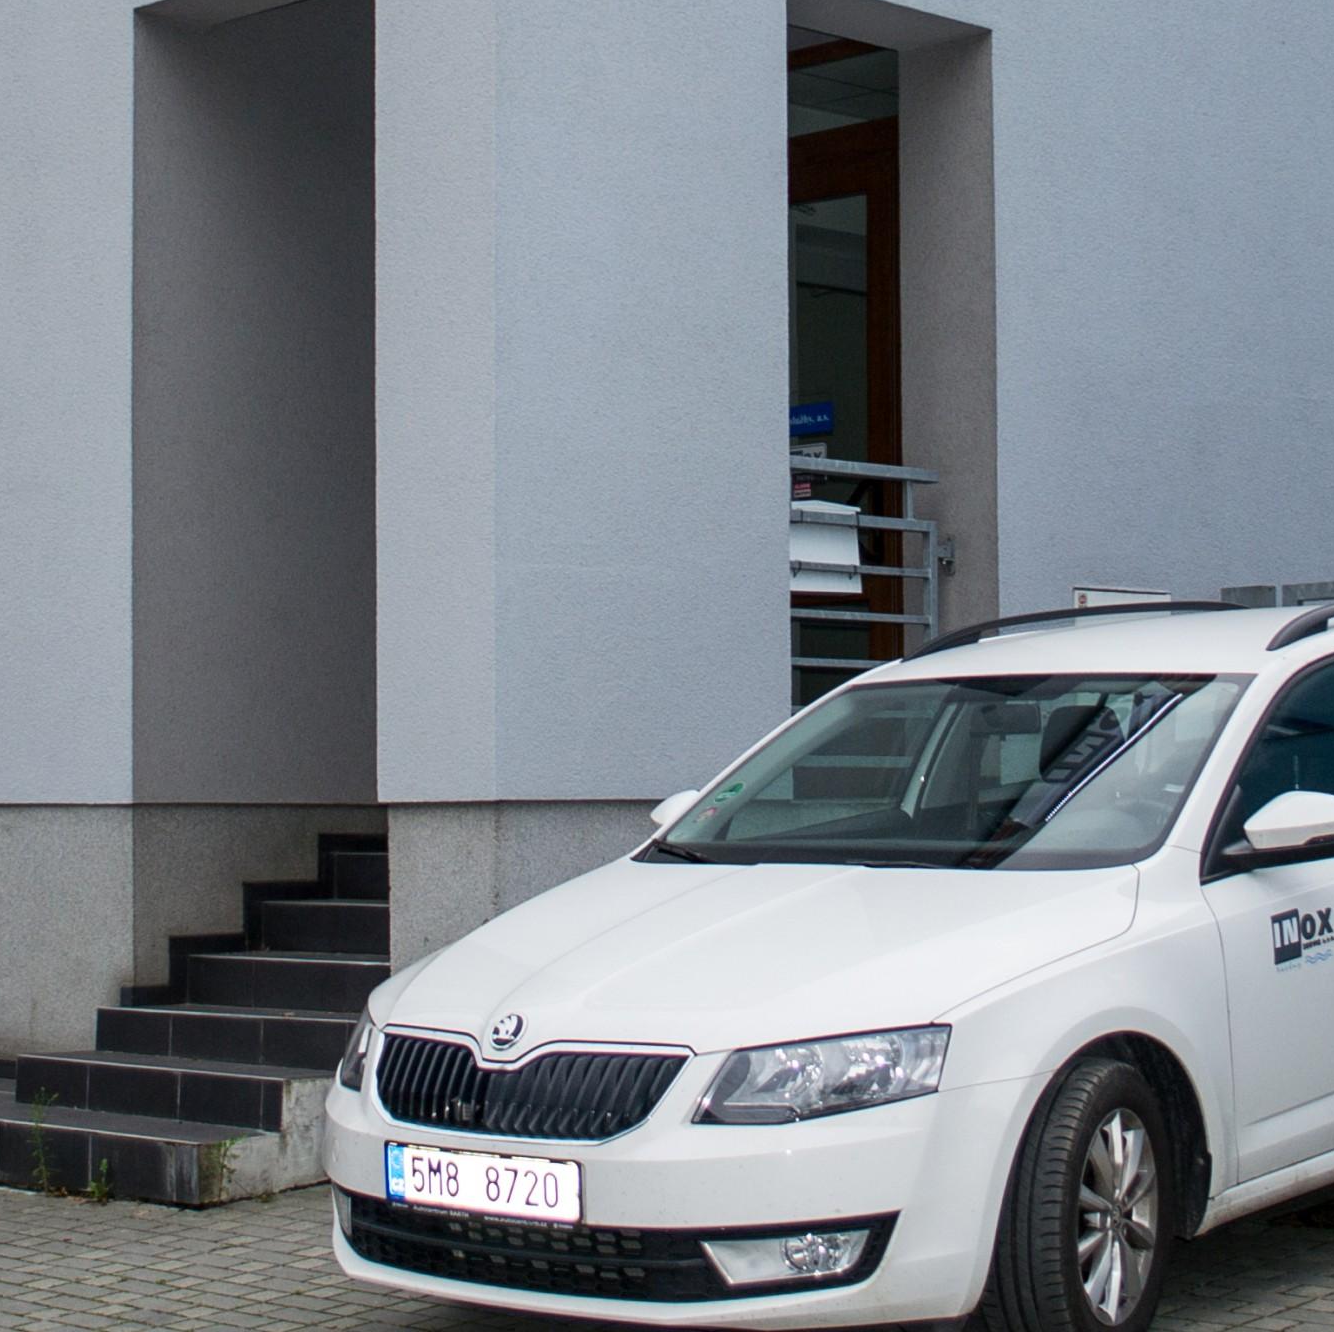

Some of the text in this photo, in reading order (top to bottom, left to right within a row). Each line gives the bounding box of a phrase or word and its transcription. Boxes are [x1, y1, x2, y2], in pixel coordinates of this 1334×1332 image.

[1273, 907, 1334, 949] INOX
[411, 1156, 559, 1209] 5M8 8720
